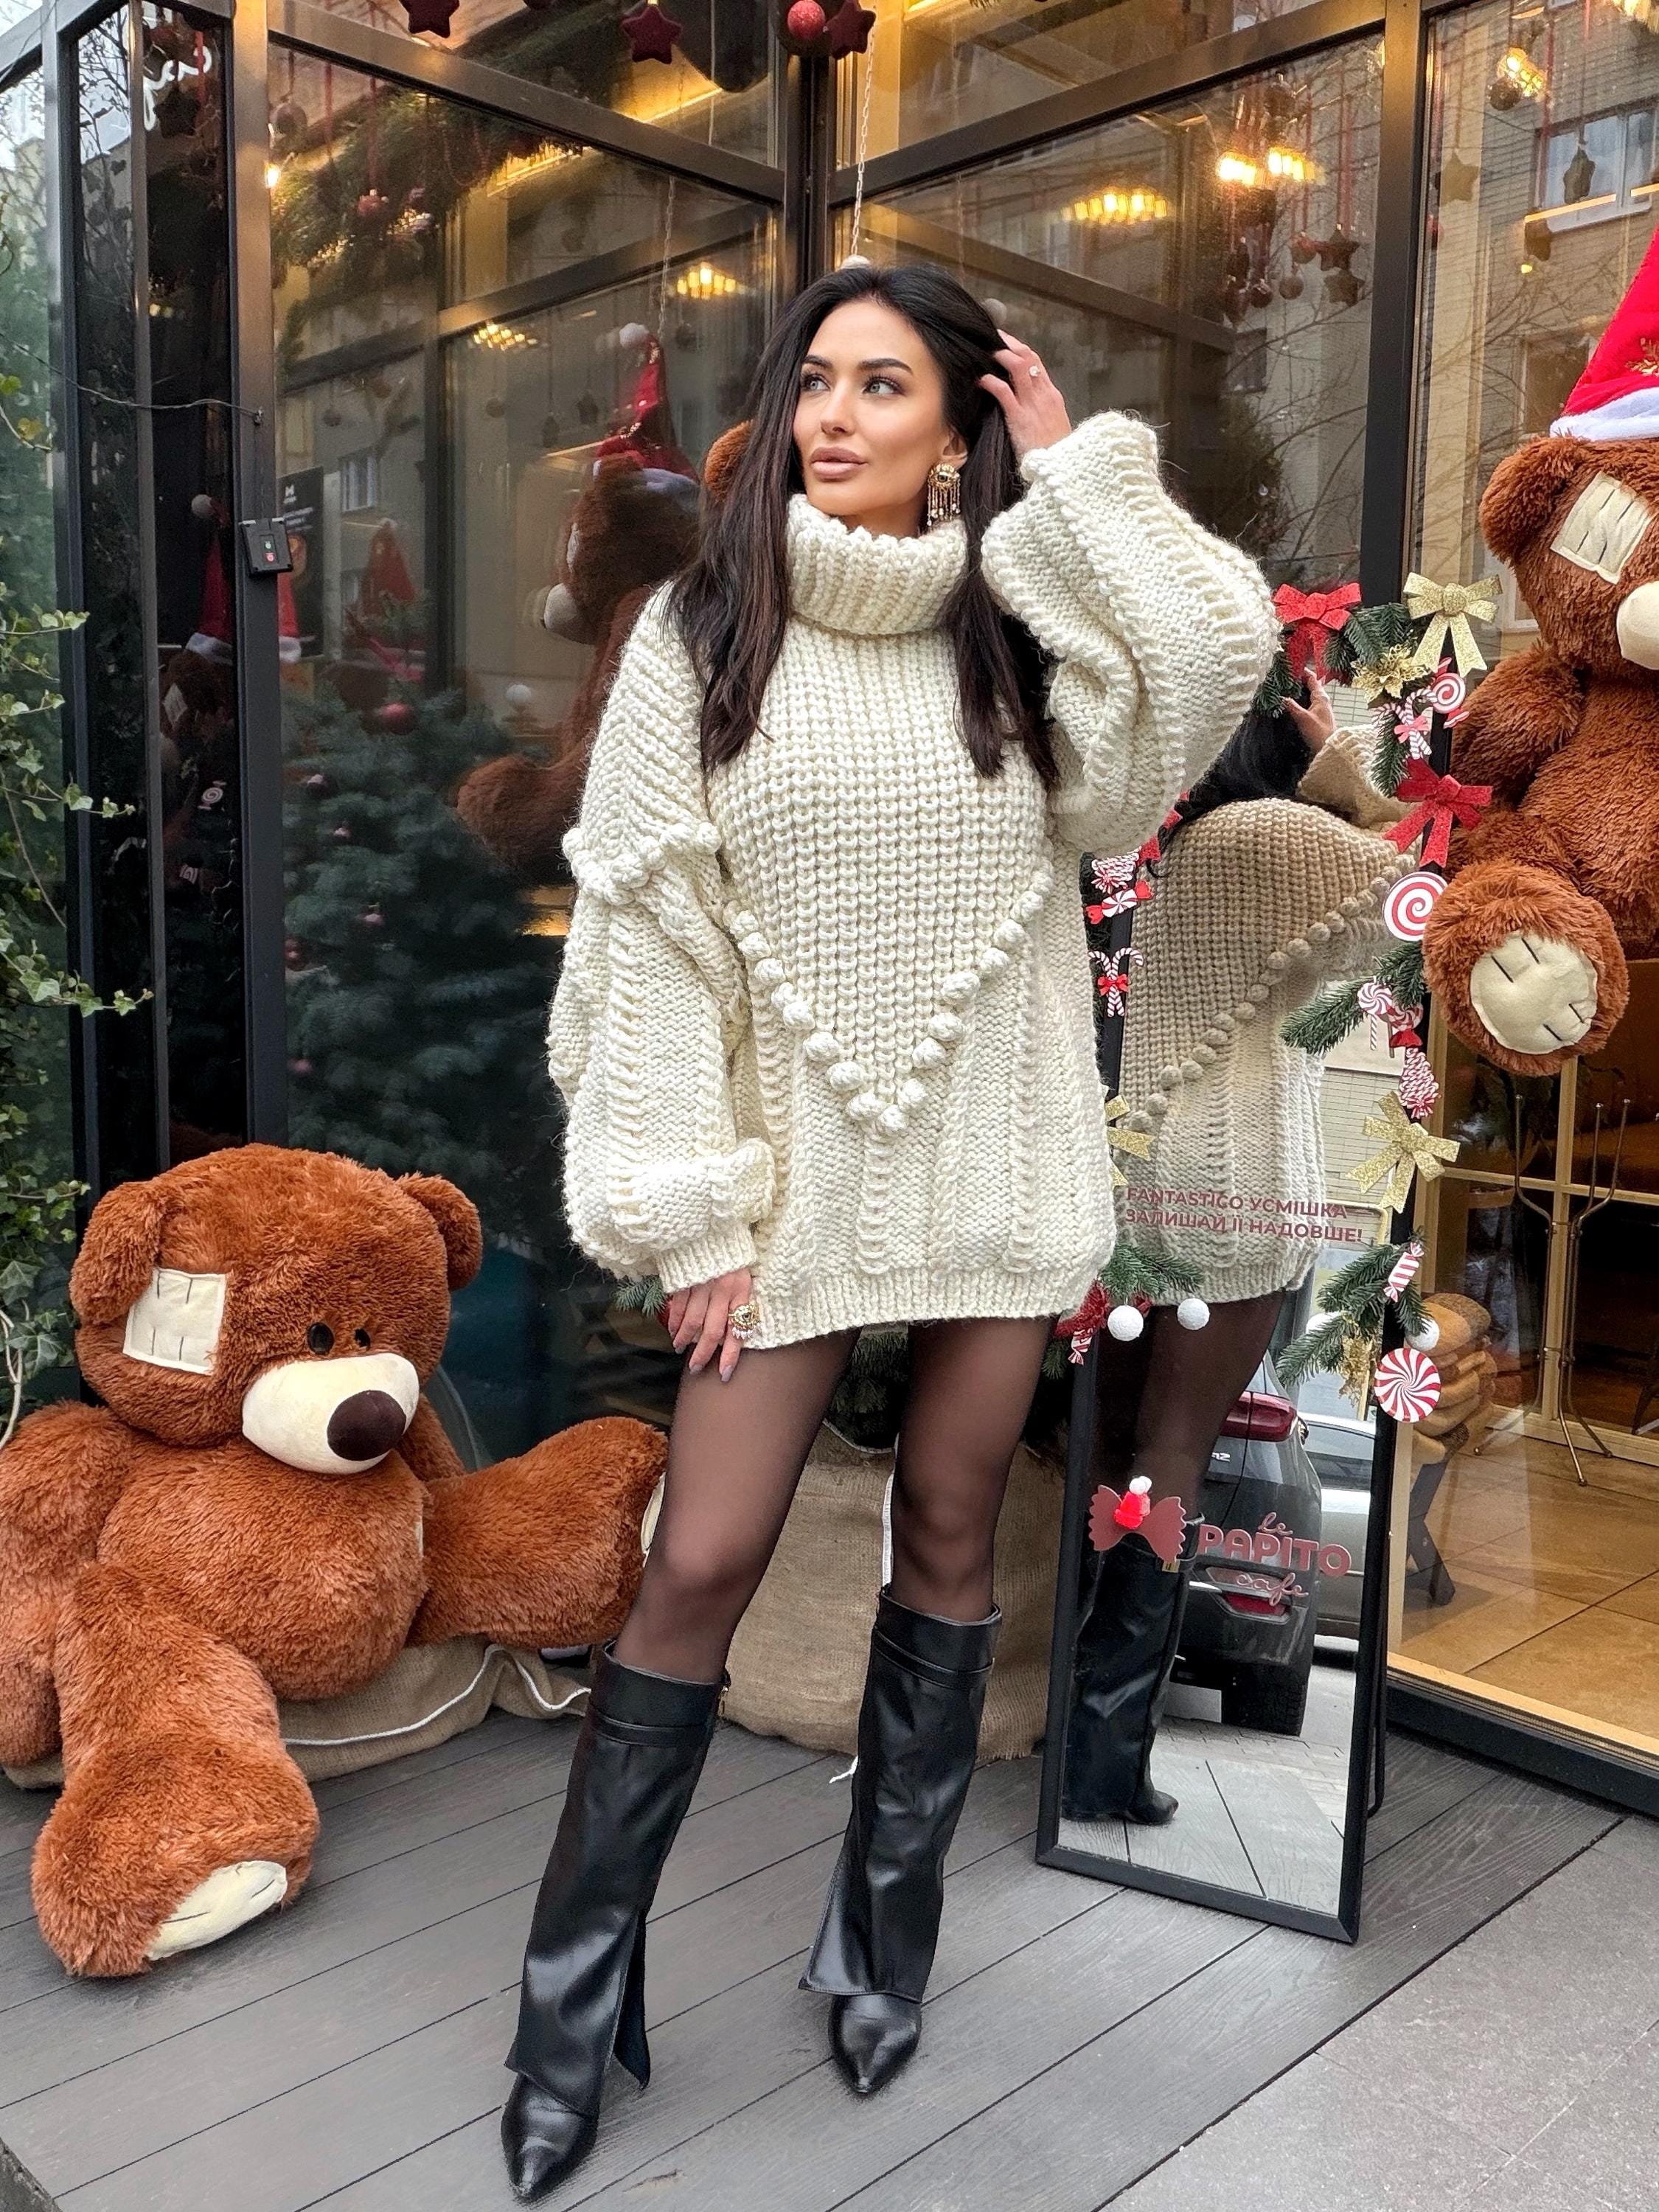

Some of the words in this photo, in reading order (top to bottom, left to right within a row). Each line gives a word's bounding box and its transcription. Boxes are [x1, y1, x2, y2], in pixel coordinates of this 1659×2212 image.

[1127, 1188, 1244, 1209] FANTASTICO
[1197, 1523, 1352, 1576] PAPITO
[1237, 1572, 1309, 1606] cafe
